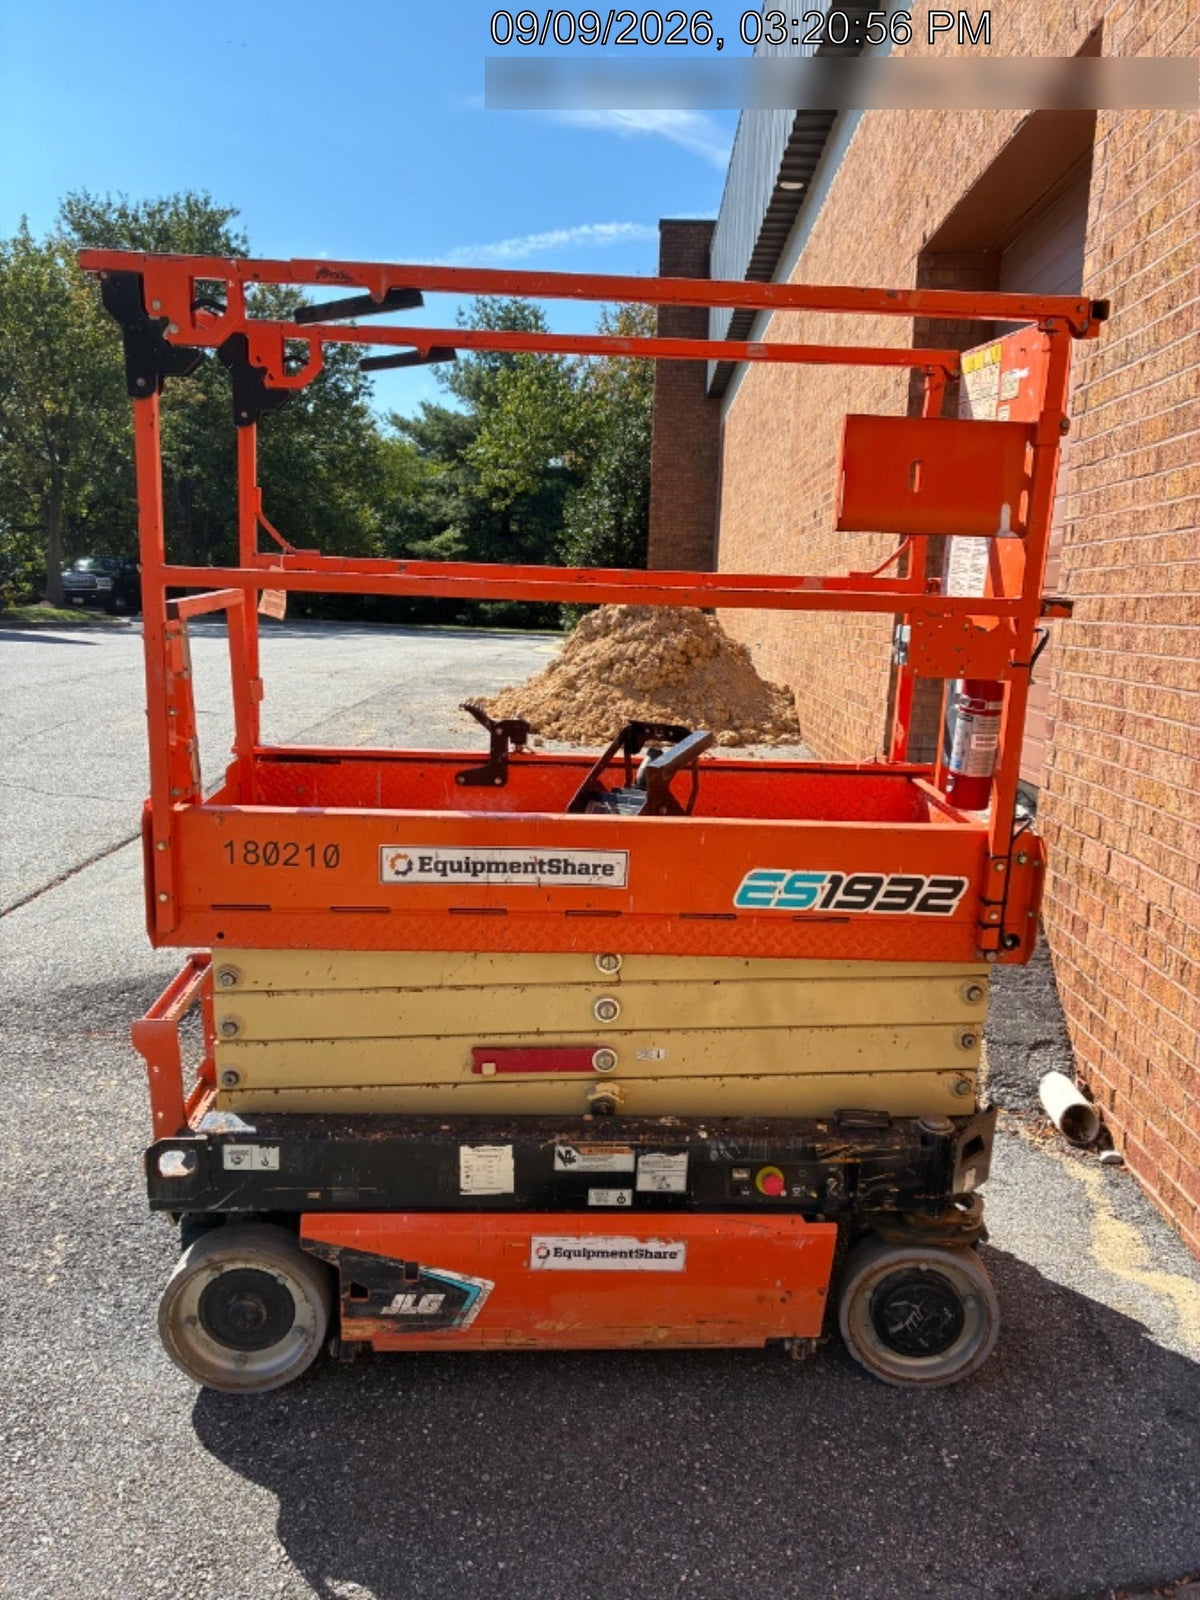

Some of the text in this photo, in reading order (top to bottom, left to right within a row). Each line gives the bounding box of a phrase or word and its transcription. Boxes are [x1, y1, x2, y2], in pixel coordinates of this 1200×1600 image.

[223, 839, 341, 869] 180210
[417, 855, 616, 877] EquipmentShare
[735, 869, 967, 915] ES1932
[552, 1247, 679, 1260] EquipmentShare
[380, 1293, 446, 1315] JLG
